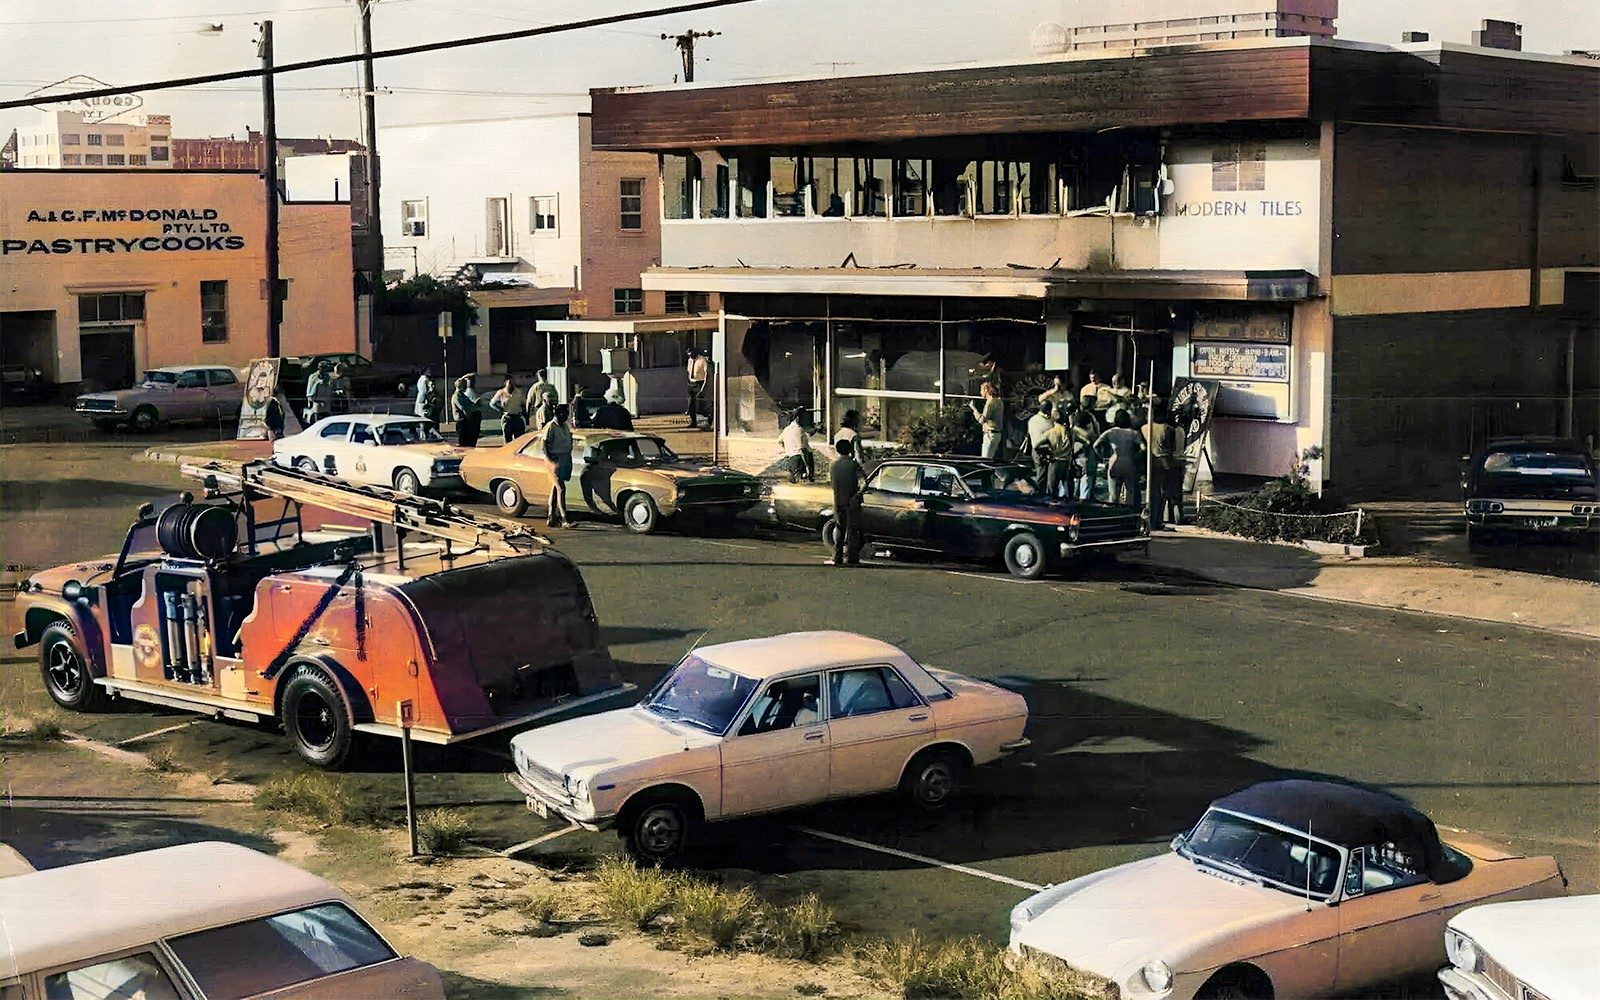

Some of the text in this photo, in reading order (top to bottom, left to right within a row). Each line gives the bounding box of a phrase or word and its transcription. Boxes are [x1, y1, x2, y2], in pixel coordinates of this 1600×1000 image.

[1175, 201, 1302, 217] MODERN TILES
[2, 235, 245, 256] PASTRYCOOKS
